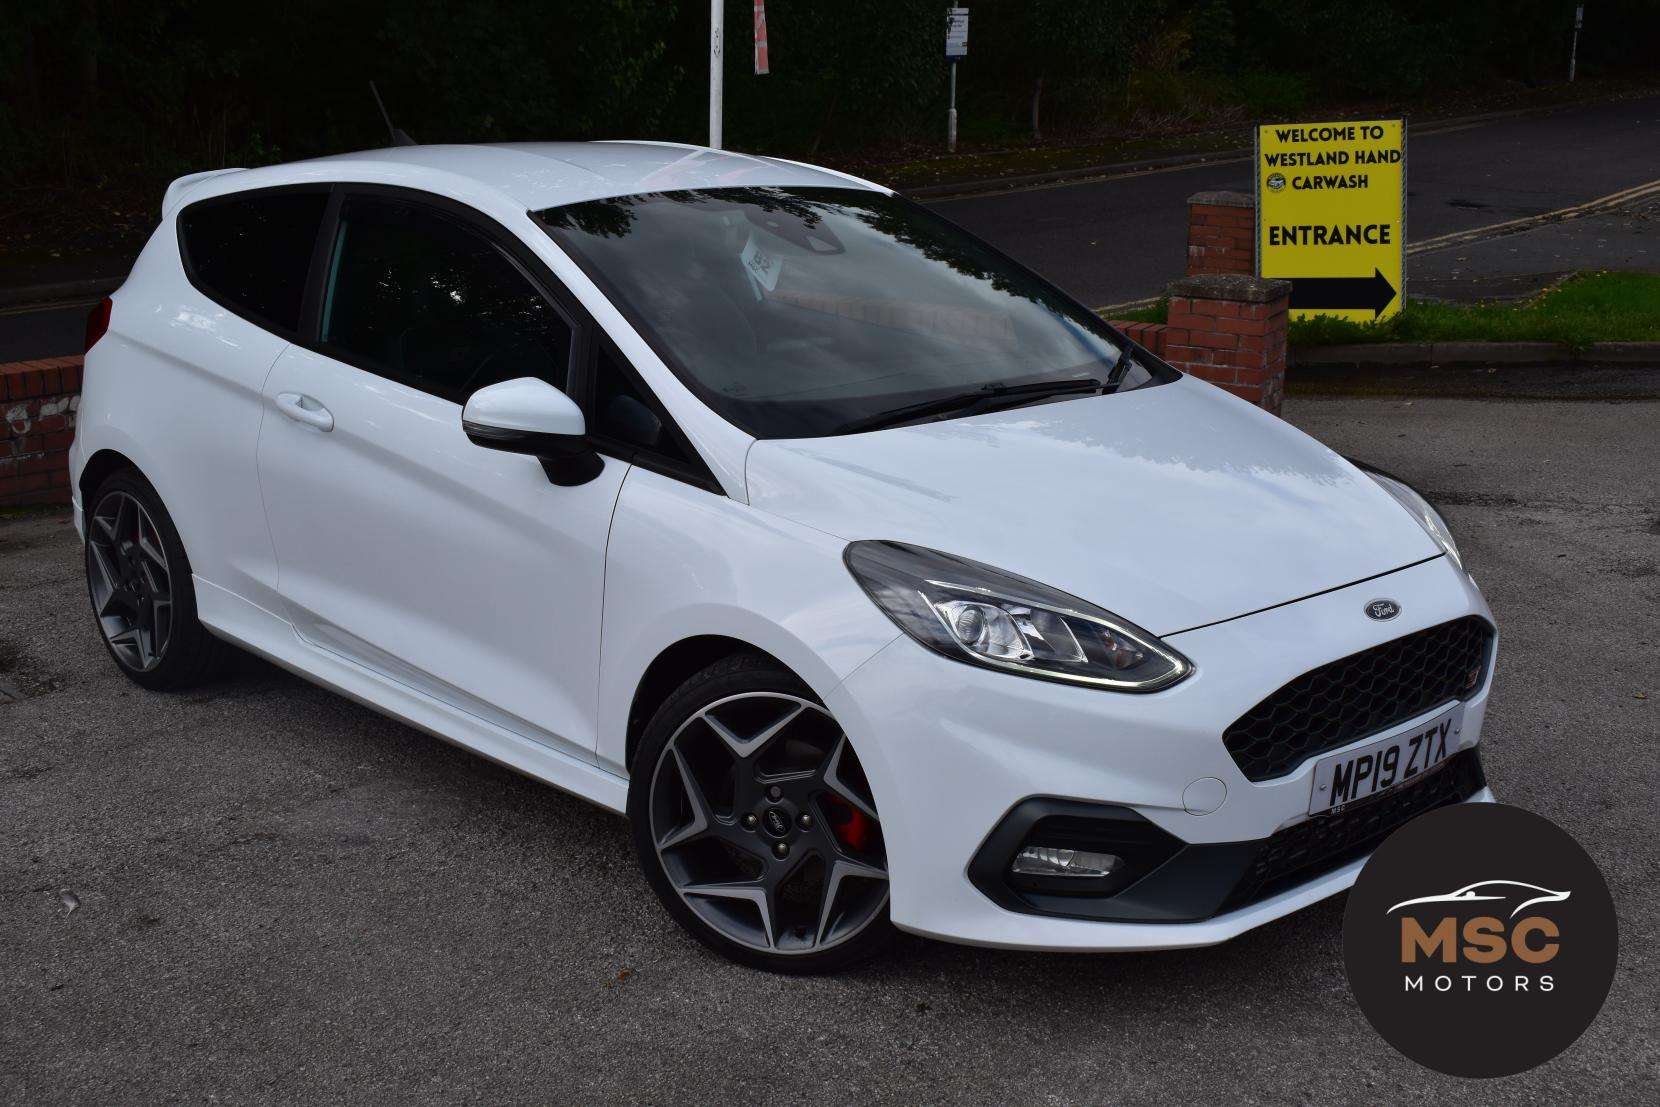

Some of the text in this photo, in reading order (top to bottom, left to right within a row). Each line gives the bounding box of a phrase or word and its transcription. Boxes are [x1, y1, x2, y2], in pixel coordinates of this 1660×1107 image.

[1276, 125, 1384, 142] WELCOME TO
[1264, 150, 1400, 167] WESTLAND HAND
[1292, 174, 1369, 190] CARWASH
[1269, 224, 1391, 246] ENTRANCE
[1373, 603, 1395, 617] Ford
[1330, 745, 1400, 804] MP19
[1403, 718, 1452, 779] ZTX
